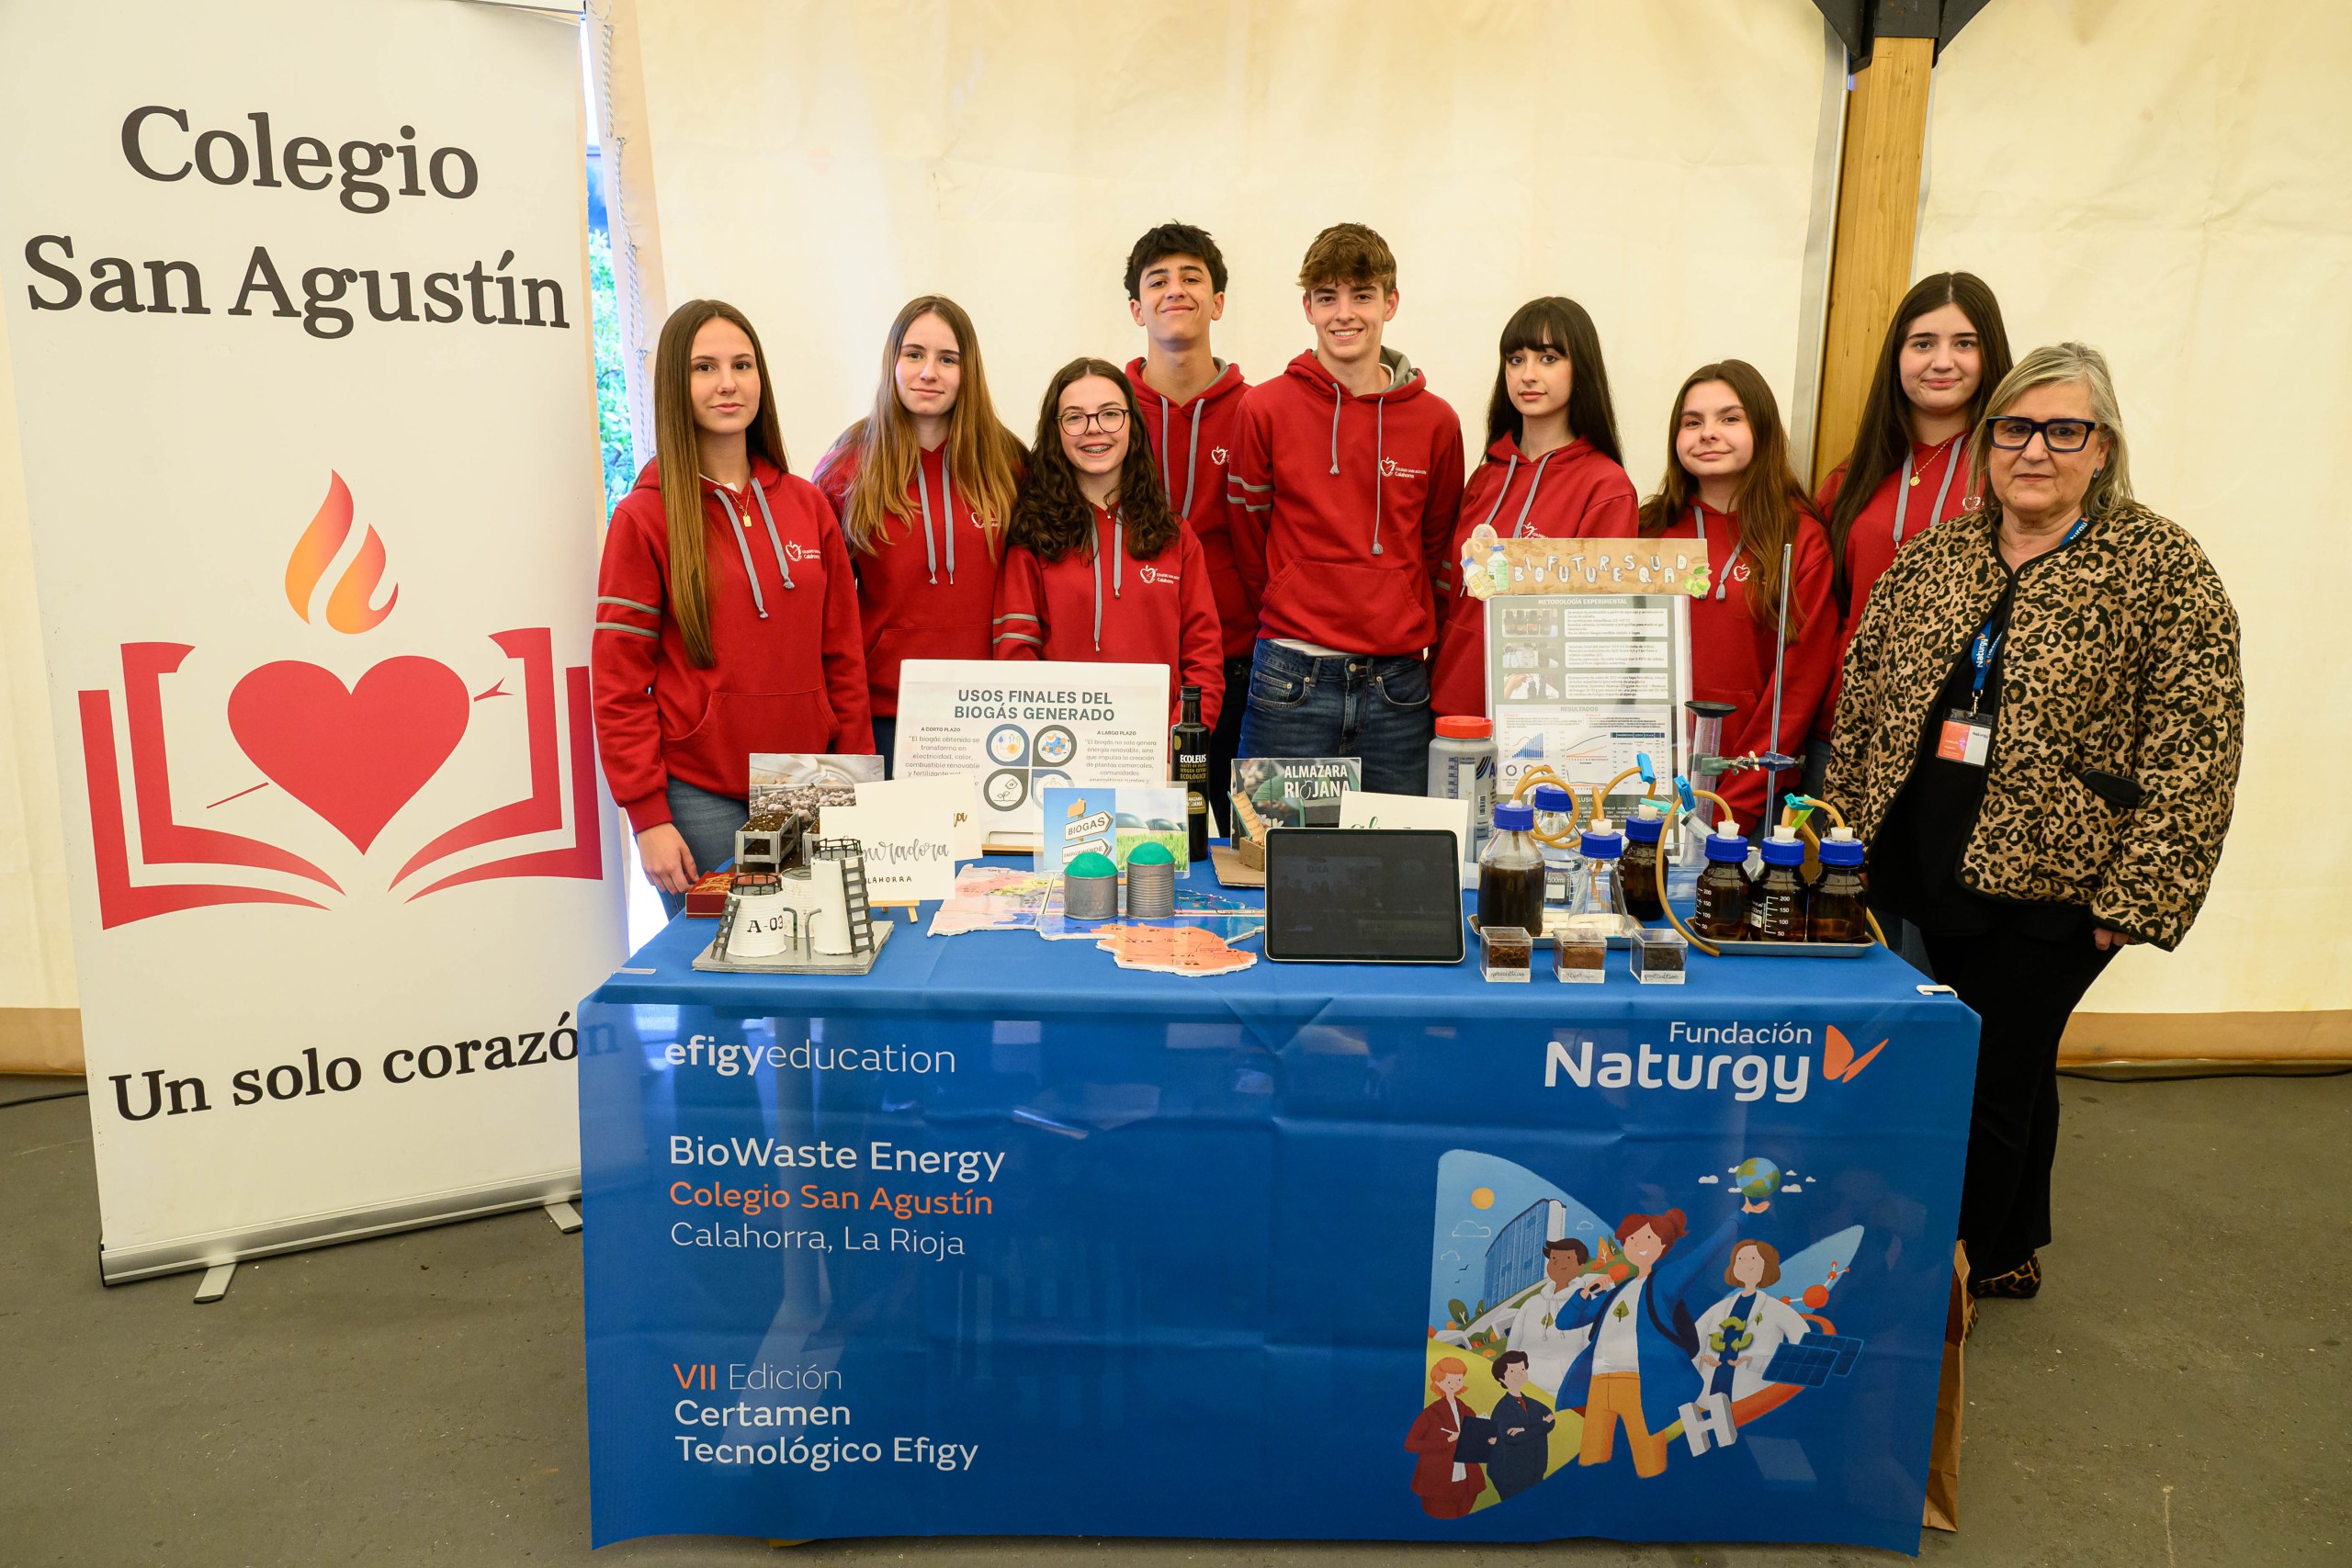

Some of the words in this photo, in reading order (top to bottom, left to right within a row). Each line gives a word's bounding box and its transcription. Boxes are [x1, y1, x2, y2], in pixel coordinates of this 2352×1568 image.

[121, 105, 479, 214] Colegio
[24, 234, 211, 314] San
[228, 245, 570, 339] Agustín
[1976, 638, 1988, 668] Naturgy
[955, 703, 1017, 719] BIOGÁS
[1023, 707, 1114, 721] GENERADO
[958, 690, 1003, 702] USOS
[1009, 690, 1076, 704] FINALES
[1082, 692, 1113, 705] DEL
[1180, 754, 1206, 763] ECOLEUS
[1283, 764, 1348, 778] ALMAZARA
[1069, 818, 1105, 835] BIOGAS
[866, 875, 912, 884] LAHORRA
[1669, 1021, 1812, 1044] Fundación
[664, 1034, 956, 1077] efigyeducation
[108, 1069, 211, 1122] Un
[232, 1047, 362, 1107] solo
[1544, 1041, 1810, 1103] Naturgy
[670, 1135, 857, 1169] BioWaste
[871, 1141, 1005, 1183] Energy
[670, 1181, 790, 1216] Colegio
[800, 1184, 859, 1211] San
[870, 1187, 992, 1220] Agustín
[671, 1222, 832, 1254] Calahorra,
[844, 1226, 880, 1252] La
[890, 1228, 966, 1262] Rioja
[673, 1363, 716, 1391] VII
[729, 1363, 842, 1390] Edición
[674, 1399, 851, 1427] Certamen
[674, 1435, 882, 1472] Tecnológico
[894, 1437, 978, 1472] Efigy
